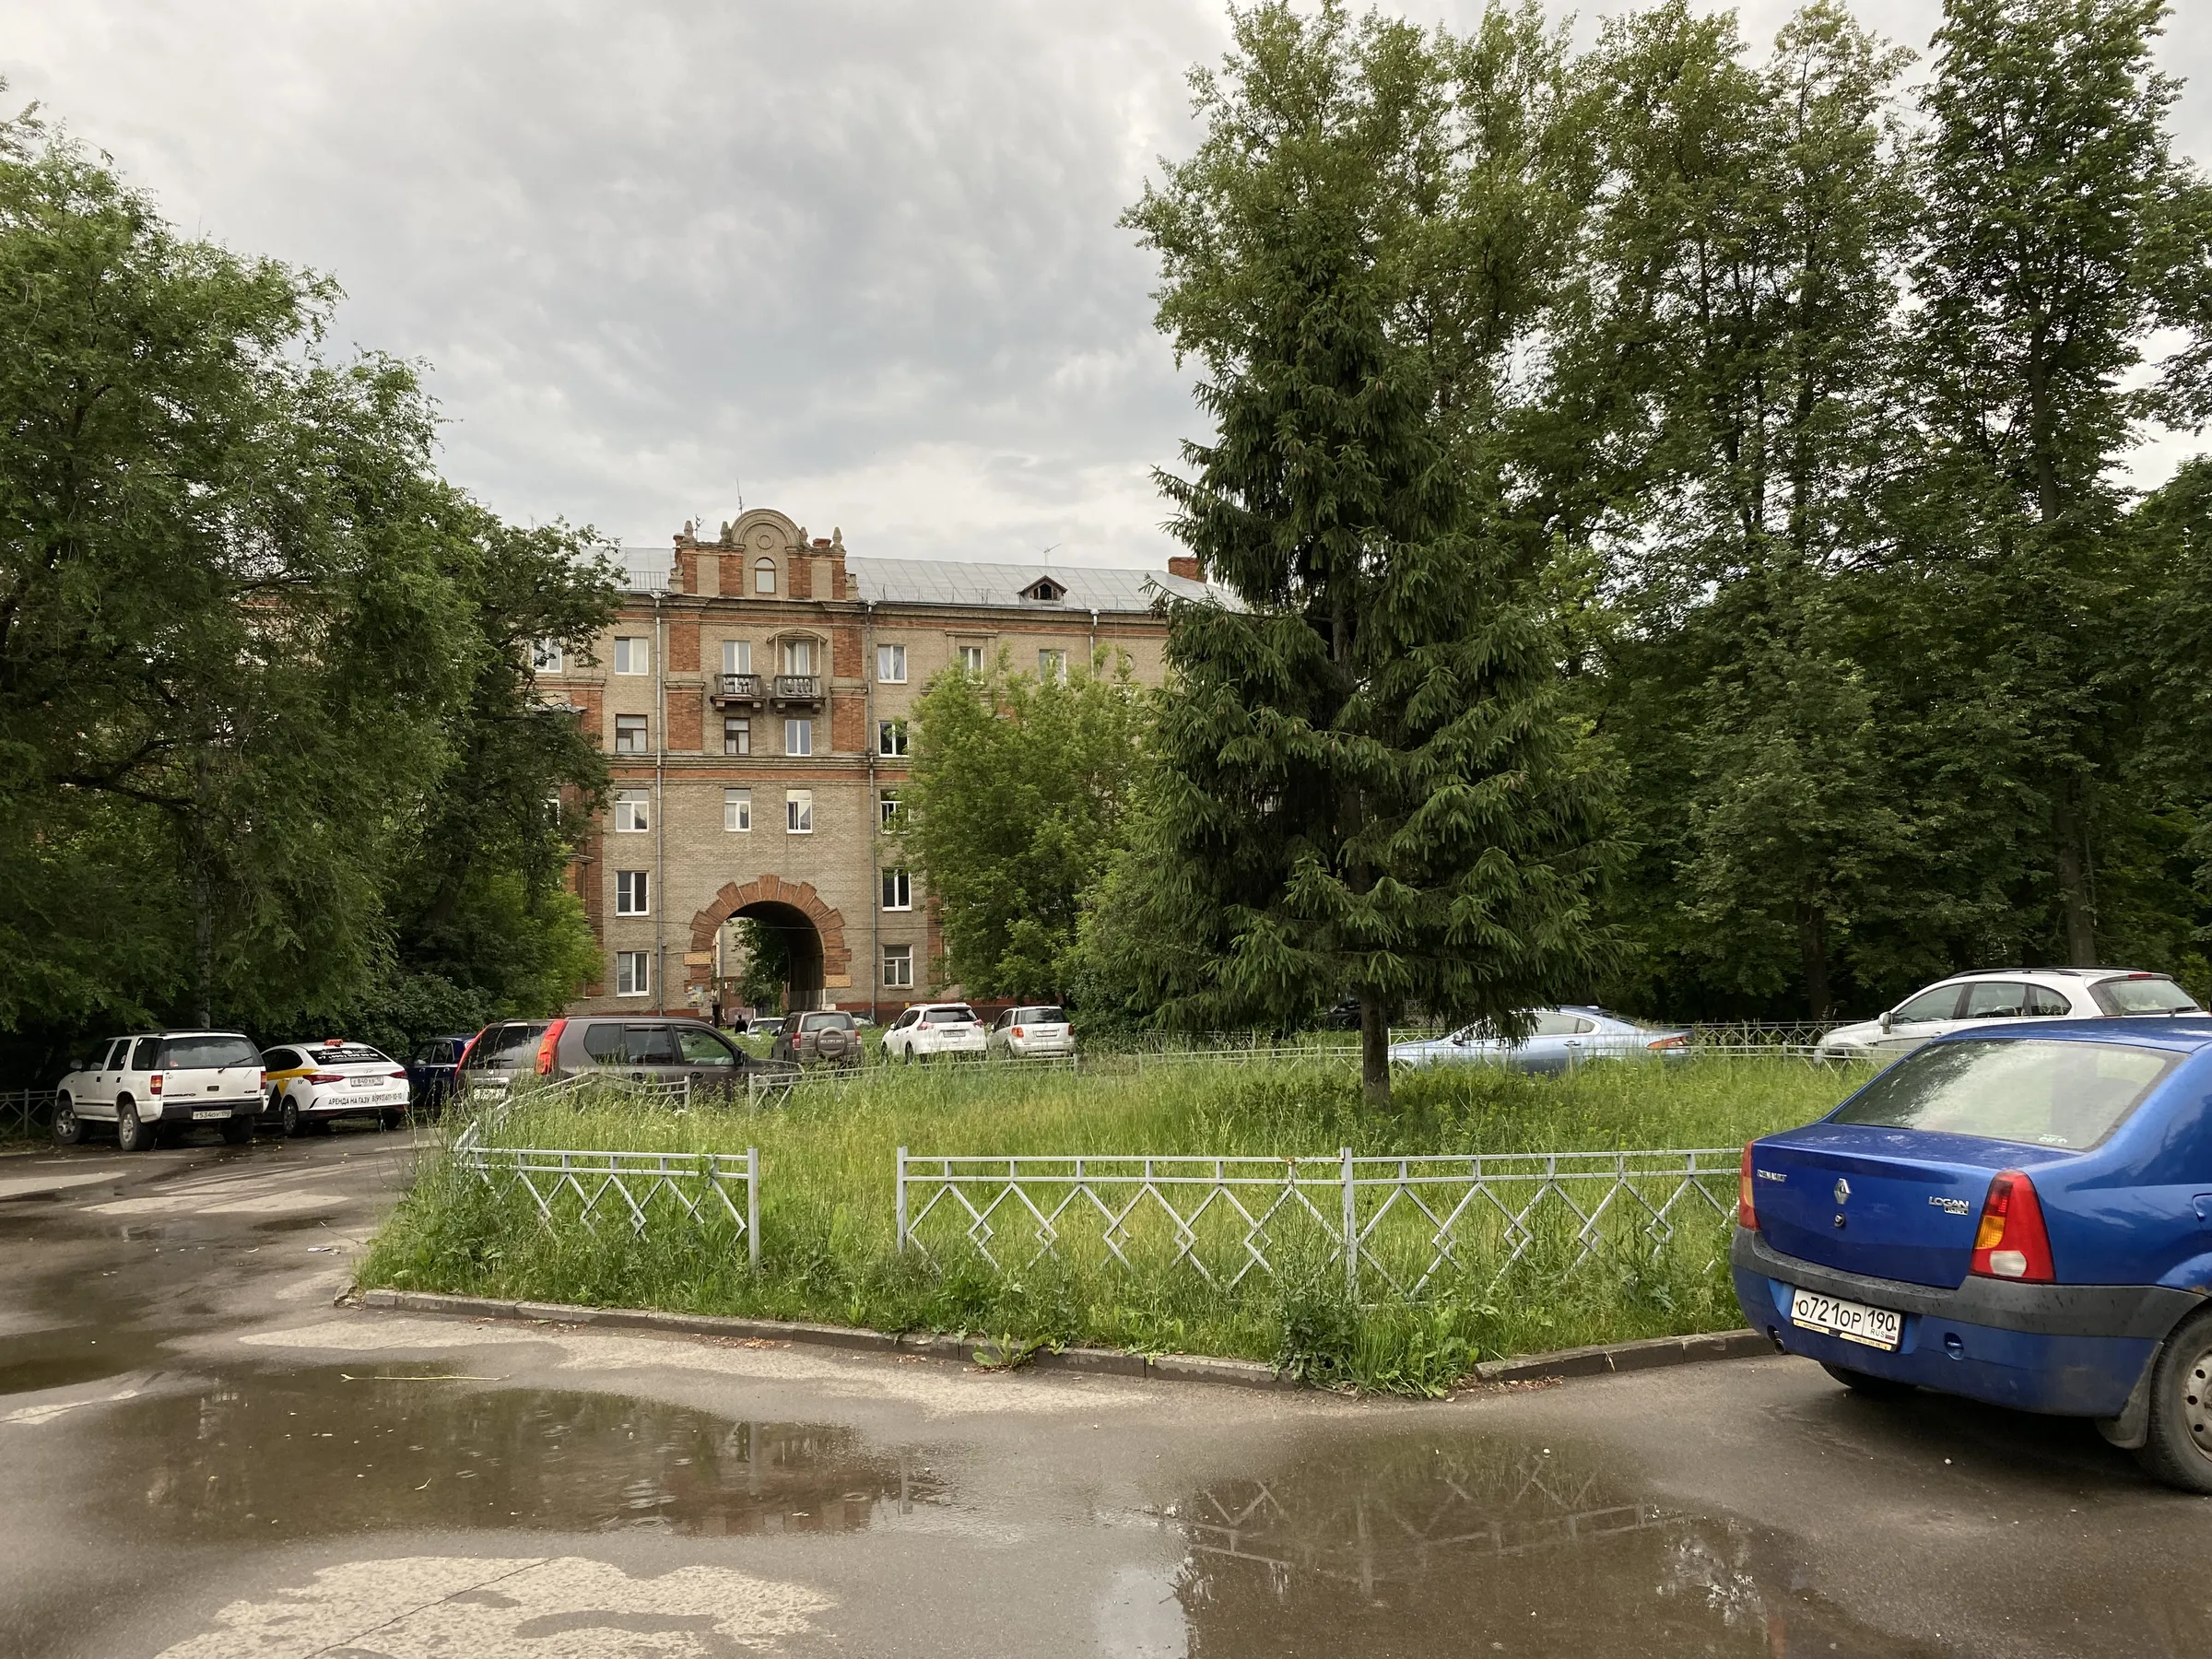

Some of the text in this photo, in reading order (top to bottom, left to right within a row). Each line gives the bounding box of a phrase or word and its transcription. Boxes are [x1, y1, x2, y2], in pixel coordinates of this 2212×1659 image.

[328, 1097, 349, 1105] АРЕНДА
[359, 1096, 371, 1104] ГАЗУ
[1928, 1195, 1970, 1209] LOGAN
[1798, 1296, 1896, 1332] О721ОР 190
[1870, 1328, 1885, 1338] RUS
